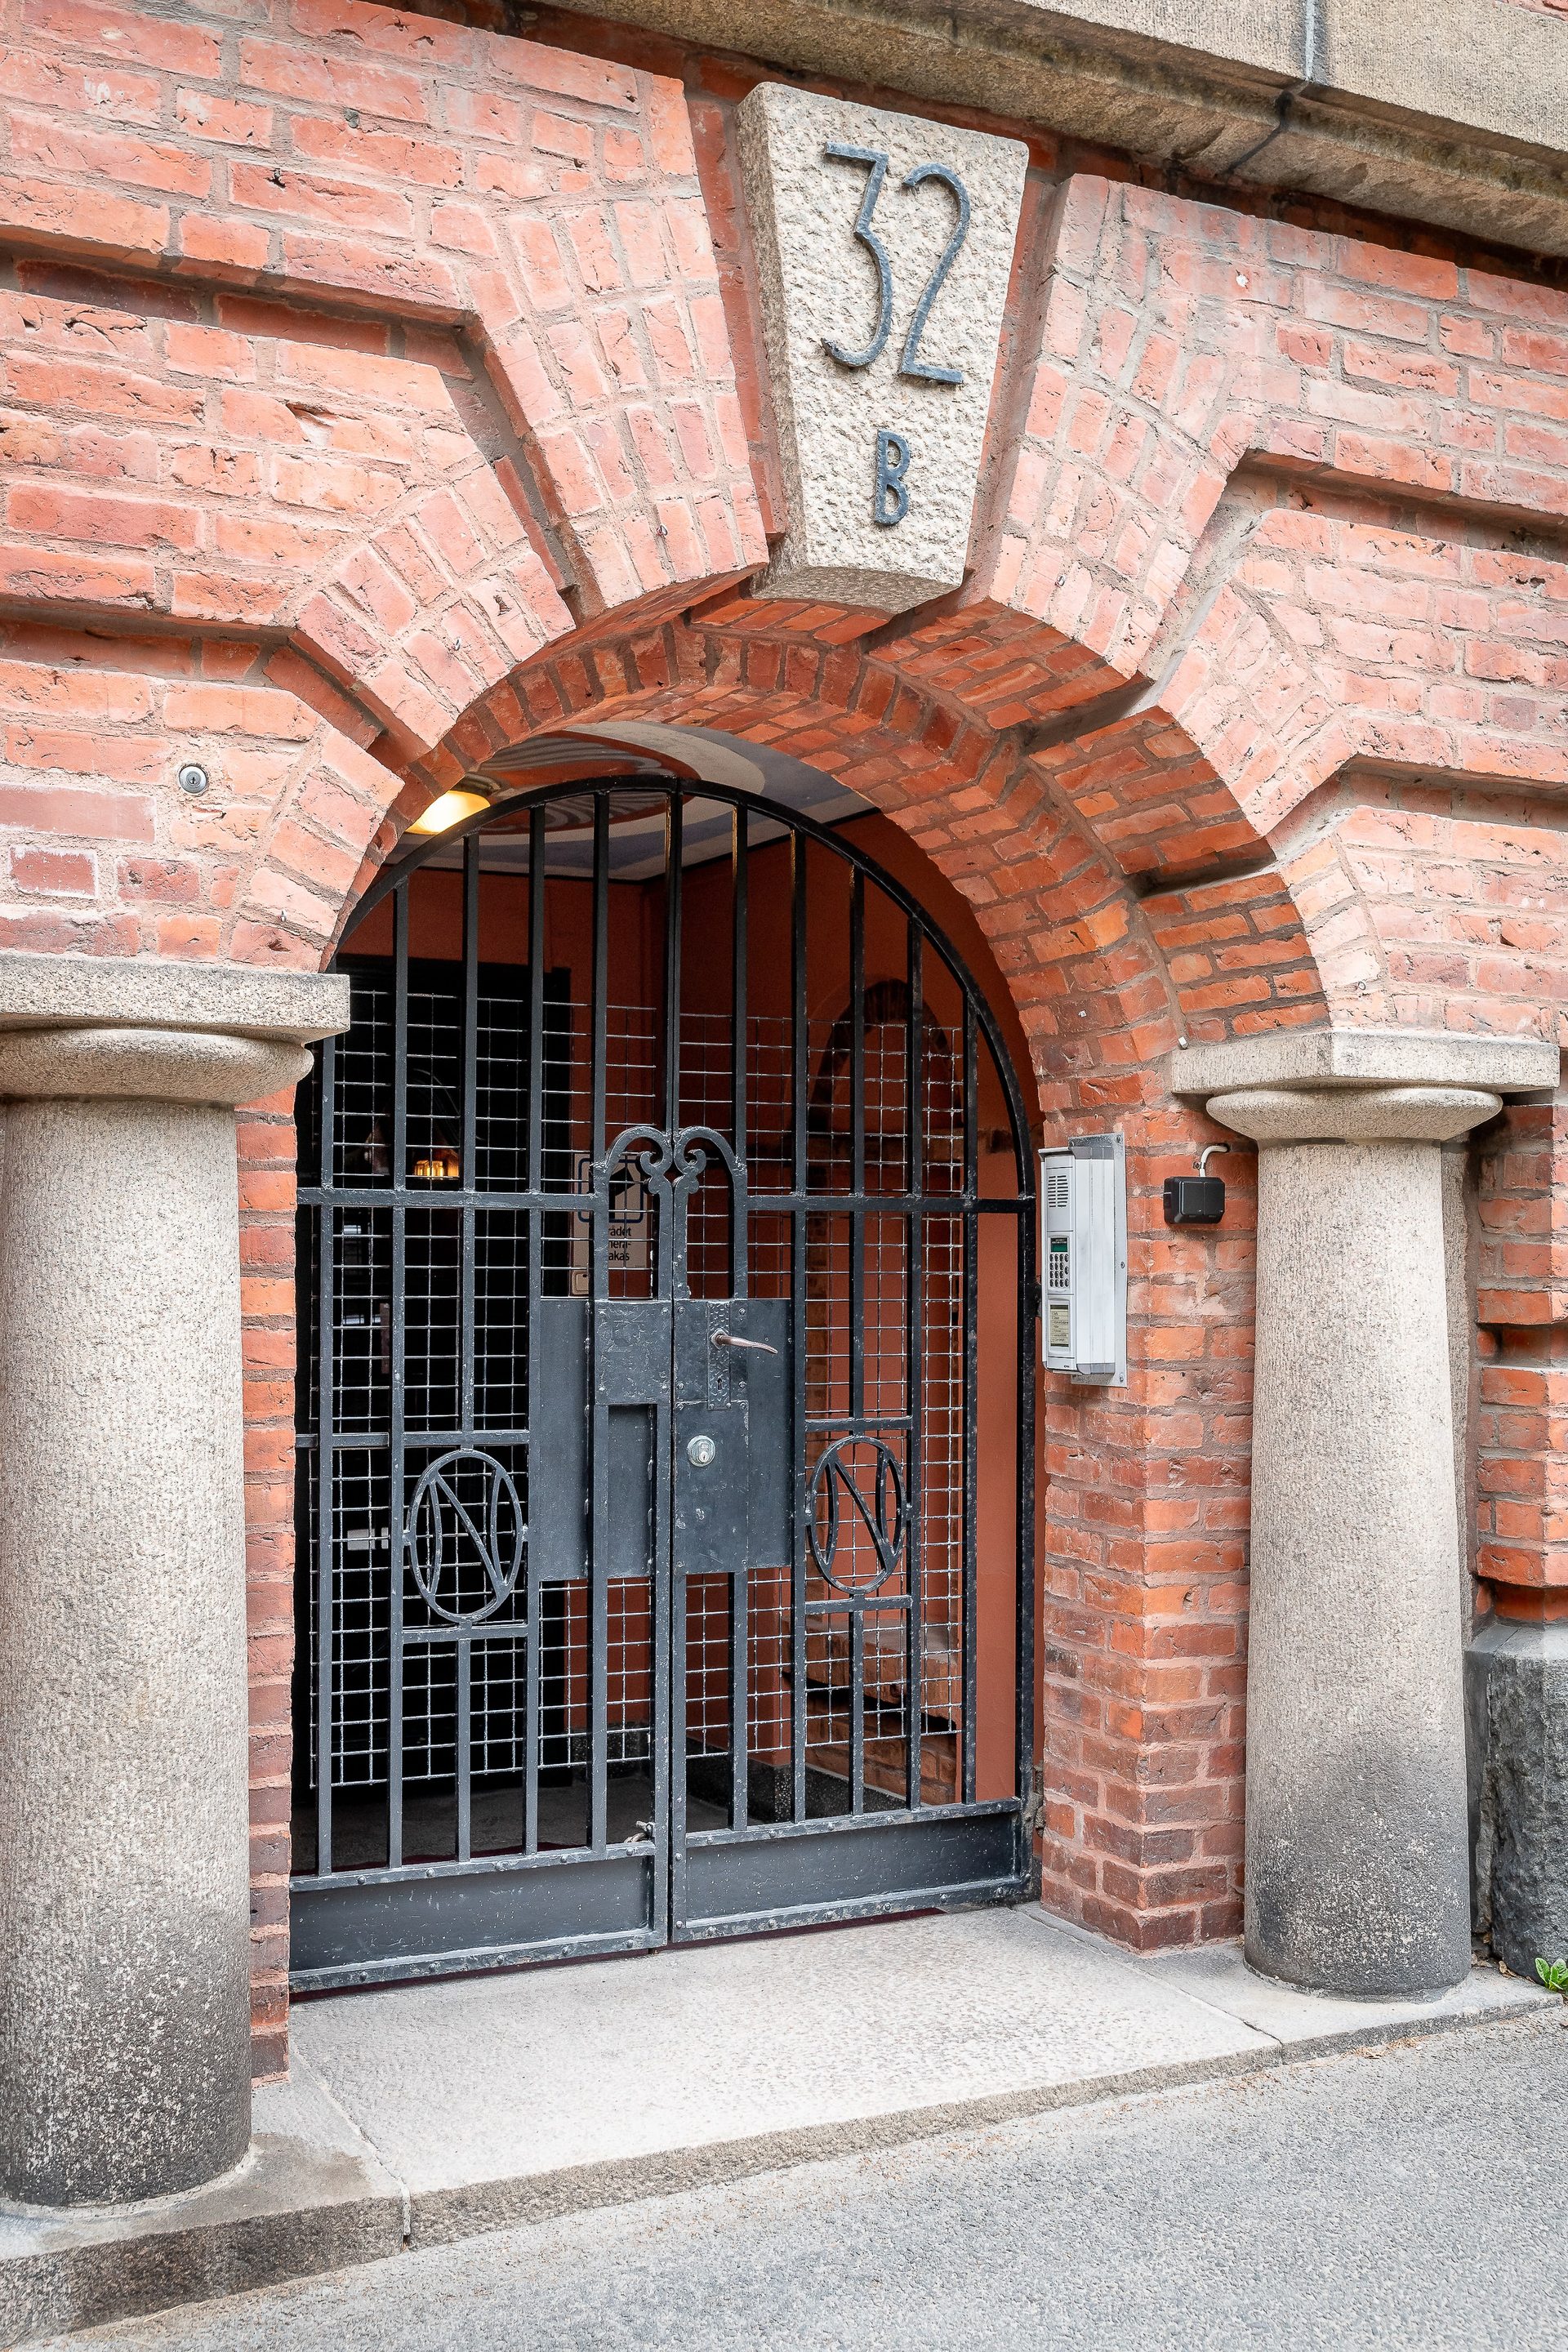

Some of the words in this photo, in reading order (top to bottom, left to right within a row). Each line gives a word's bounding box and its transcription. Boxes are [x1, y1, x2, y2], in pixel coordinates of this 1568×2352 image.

[821, 141, 972, 385] 32
[874, 428, 911, 526] B
[608, 1225, 631, 1236] rådet
[608, 1250, 630, 1261] akas
